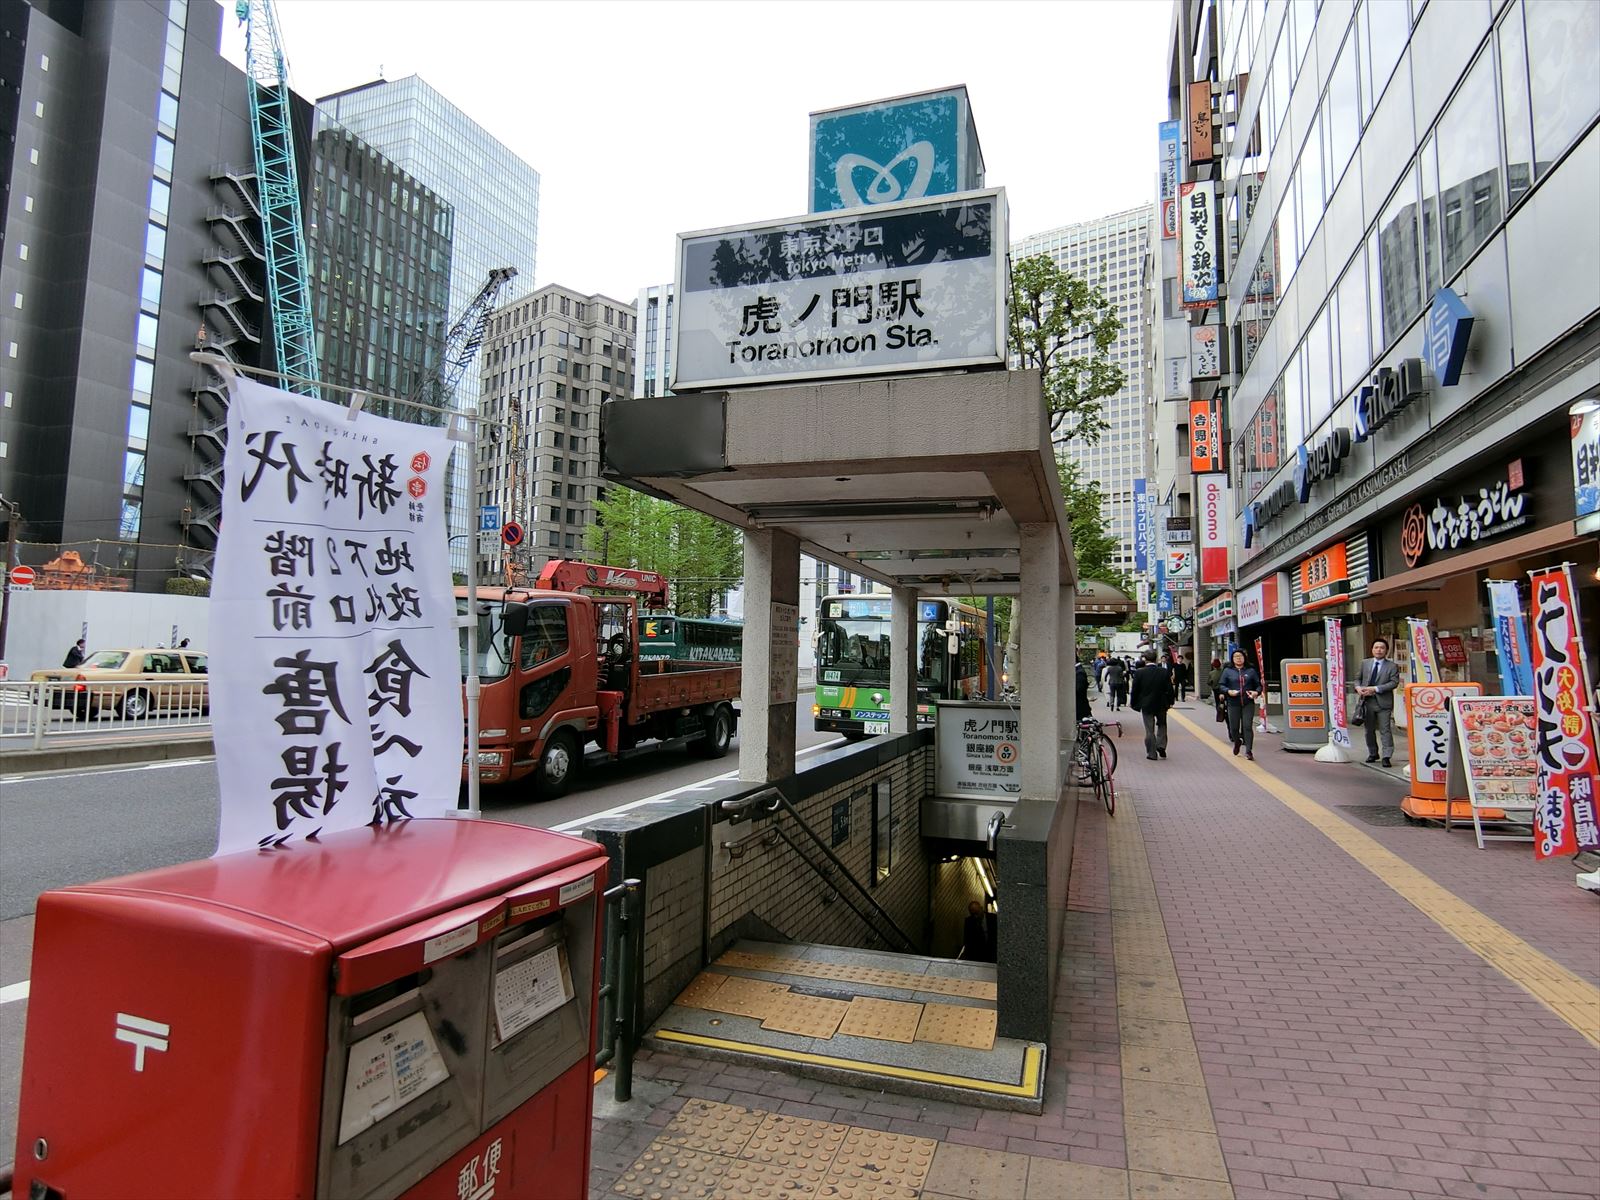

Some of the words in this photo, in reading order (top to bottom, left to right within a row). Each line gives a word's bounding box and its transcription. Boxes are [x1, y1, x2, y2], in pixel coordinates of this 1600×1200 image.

[779, 226, 884, 259] 東京メトロ
[1190, 192, 1212, 289] 目利きの銀次
[785, 257, 829, 275] Tokyo
[832, 250, 877, 267] Metro
[739, 279, 926, 337] 虎ノ門駅
[725, 333, 877, 363] Toranomon
[886, 324, 940, 351] Sta.
[1353, 358, 1422, 443] Kaikan
[1193, 414, 1209, 458] 吉野家
[1210, 412, 1218, 458] YOSHINOYA
[1357, 454, 1409, 501] KASUMIGASEKI
[1137, 493, 1147, 556] 東洋プロパティ
[1207, 482, 1219, 541] docomo
[1426, 480, 1524, 550] はなまるうどん
[1168, 530, 1189, 541] 歯科
[641, 573, 657, 583] UNIC
[1308, 554, 1328, 586] 吉野家
[1290, 674, 1320, 684] 吉野家
[962, 732, 1004, 741] Toranomon
[1005, 733, 1020, 741] Sta.
[963, 718, 1019, 734] 虎ノ門駅
[1295, 715, 1320, 723] 営業中
[966, 743, 995, 754] 銀座線
[1424, 719, 1449, 769] うどん
[968, 763, 983, 771] 銀座
[457, 1137, 503, 1200] 郵便
